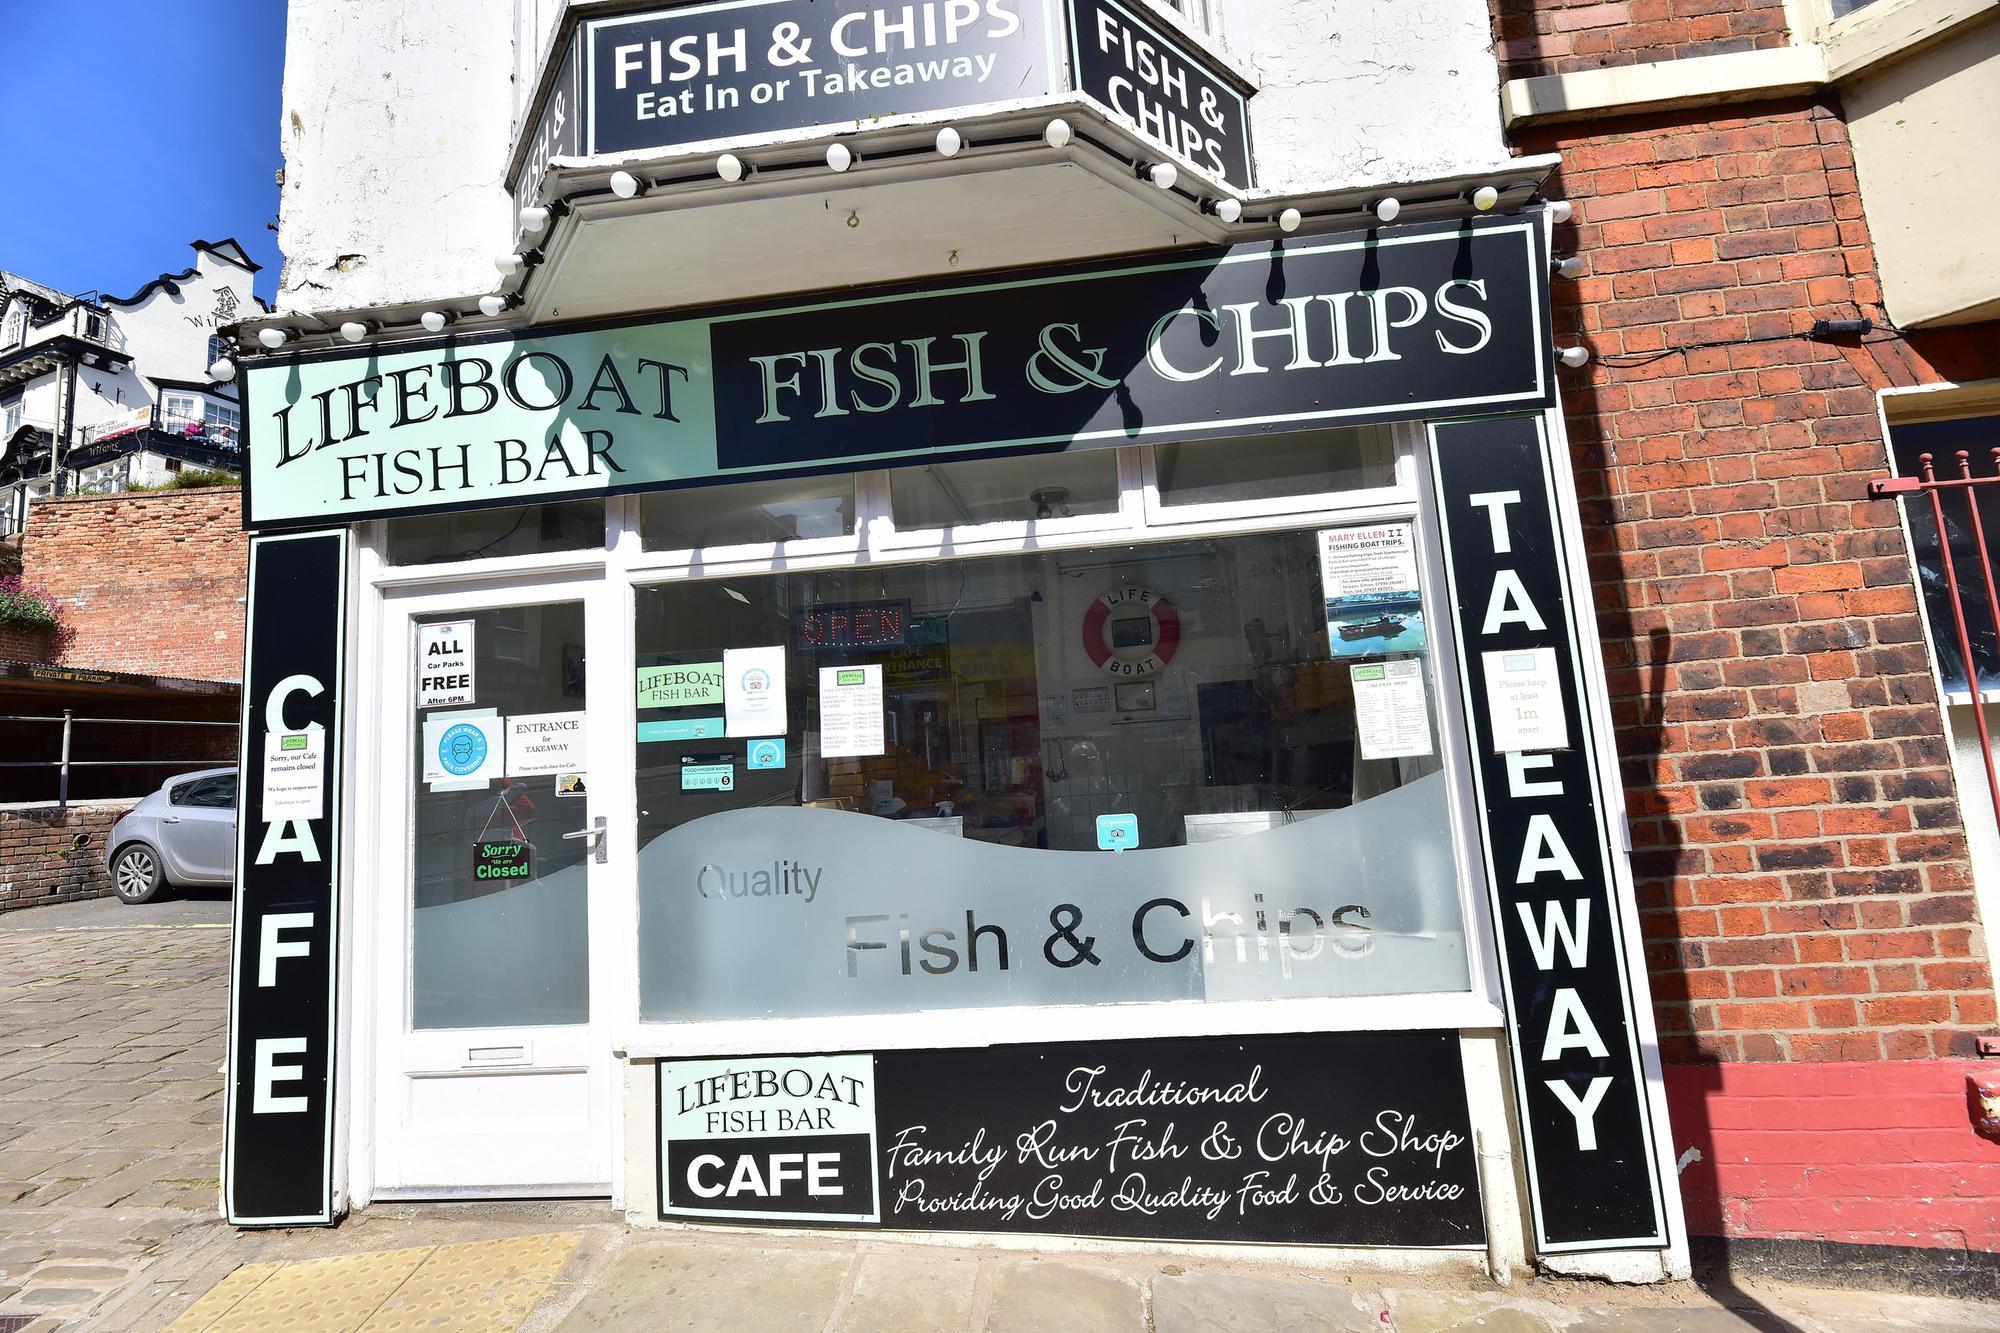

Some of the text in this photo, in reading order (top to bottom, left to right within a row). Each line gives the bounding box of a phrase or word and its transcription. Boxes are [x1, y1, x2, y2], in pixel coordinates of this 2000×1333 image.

[614, 0, 1021, 89] FISH & CHIPS
[1096, 8, 1227, 136] FISH &
[636, 52, 998, 121] Eat In or Takeaway
[1108, 75, 1226, 180] CHIPS
[749, 278, 1493, 425] FISH & CHIPS
[272, 351, 689, 469] LIFEBOAT
[337, 428, 627, 501] FISH BAR
[1328, 533, 1355, 543] MARY
[1357, 531, 1386, 541] ELLEN
[1328, 538, 1405, 551] FISHING BOAT TRIPS.
[1107, 588, 1151, 605] LIFE
[804, 609, 900, 643] OPEN
[427, 640, 464, 656] ALL
[443, 660, 464, 668] Parks
[883, 657, 943, 673] NTRANCE
[1110, 658, 1154, 675] BOAT
[36, 670, 65, 679] PRIVATE
[421, 674, 470, 691] FREE
[639, 671, 724, 694] LIFEBOAT
[1499, 678, 1546, 688] Please keep
[427, 695, 465, 705] After 6PM
[652, 687, 710, 700] FISH BAR
[1520, 692, 1538, 700] least
[515, 720, 579, 734] ENTRANCE
[1518, 726, 1540, 735] apart
[443, 728, 463, 744] PLEASE
[524, 743, 569, 753] TAKEAWAY
[270, 754, 289, 763] Sorry,
[302, 752, 317, 760] Cafe
[271, 764, 295, 772] remains
[1469, 489, 1614, 1151] TAEAWAY
[482, 844, 521, 858] Sorry
[476, 862, 529, 879] Closed
[696, 860, 823, 904] Quality
[253, 674, 325, 1114] CAFE
[845, 893, 1376, 979] Fish & Chips
[677, 1068, 864, 1116] LIFEBOAT
[1059, 1063, 1269, 1113] Traditional
[705, 1107, 837, 1134] FISH BAR
[886, 1109, 1465, 1179] Family Run Fish & Chip Shop
[686, 1152, 844, 1198] CAFE
[894, 1166, 1465, 1221] Providing Good Quality Food & Service
